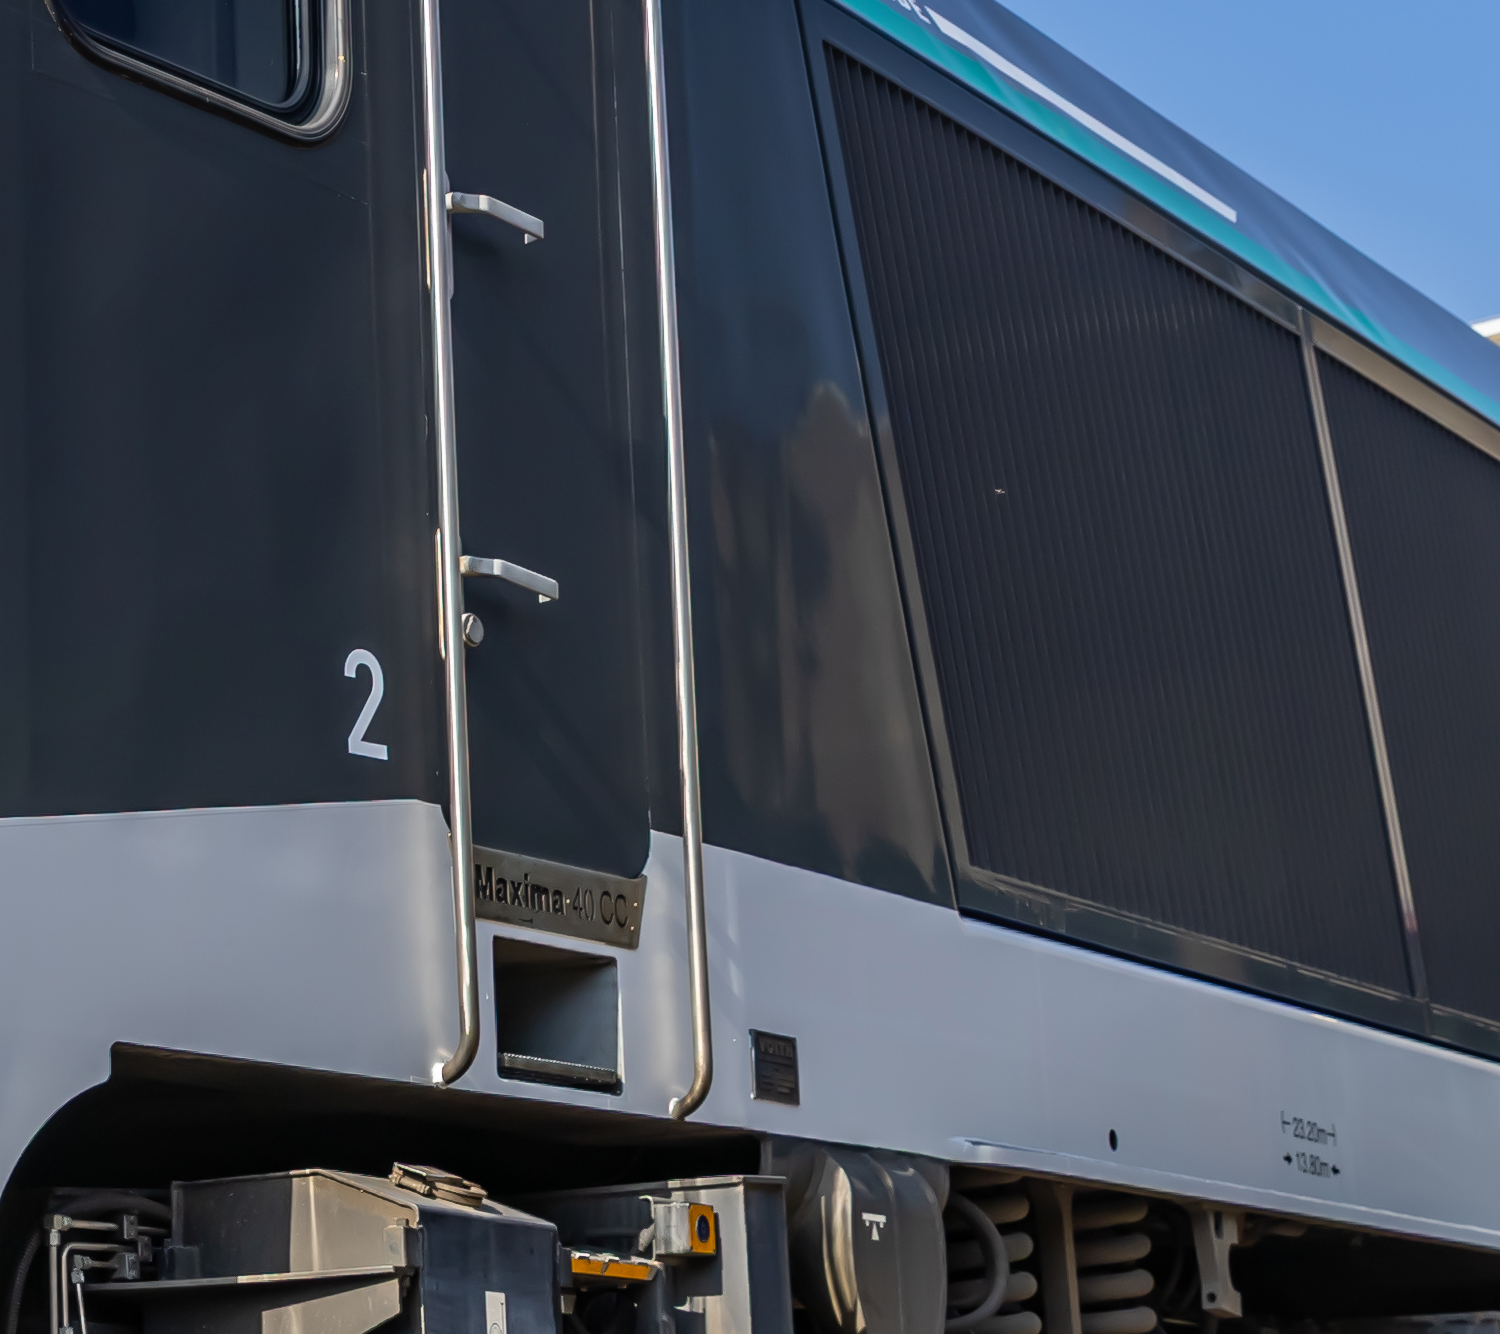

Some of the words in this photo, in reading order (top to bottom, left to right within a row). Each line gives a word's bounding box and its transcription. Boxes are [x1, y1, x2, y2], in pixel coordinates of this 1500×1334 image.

[344, 648, 388, 760] 2
[475, 864, 567, 916] Maxima
[572, 885, 596, 922] 40
[600, 890, 629, 928] CC
